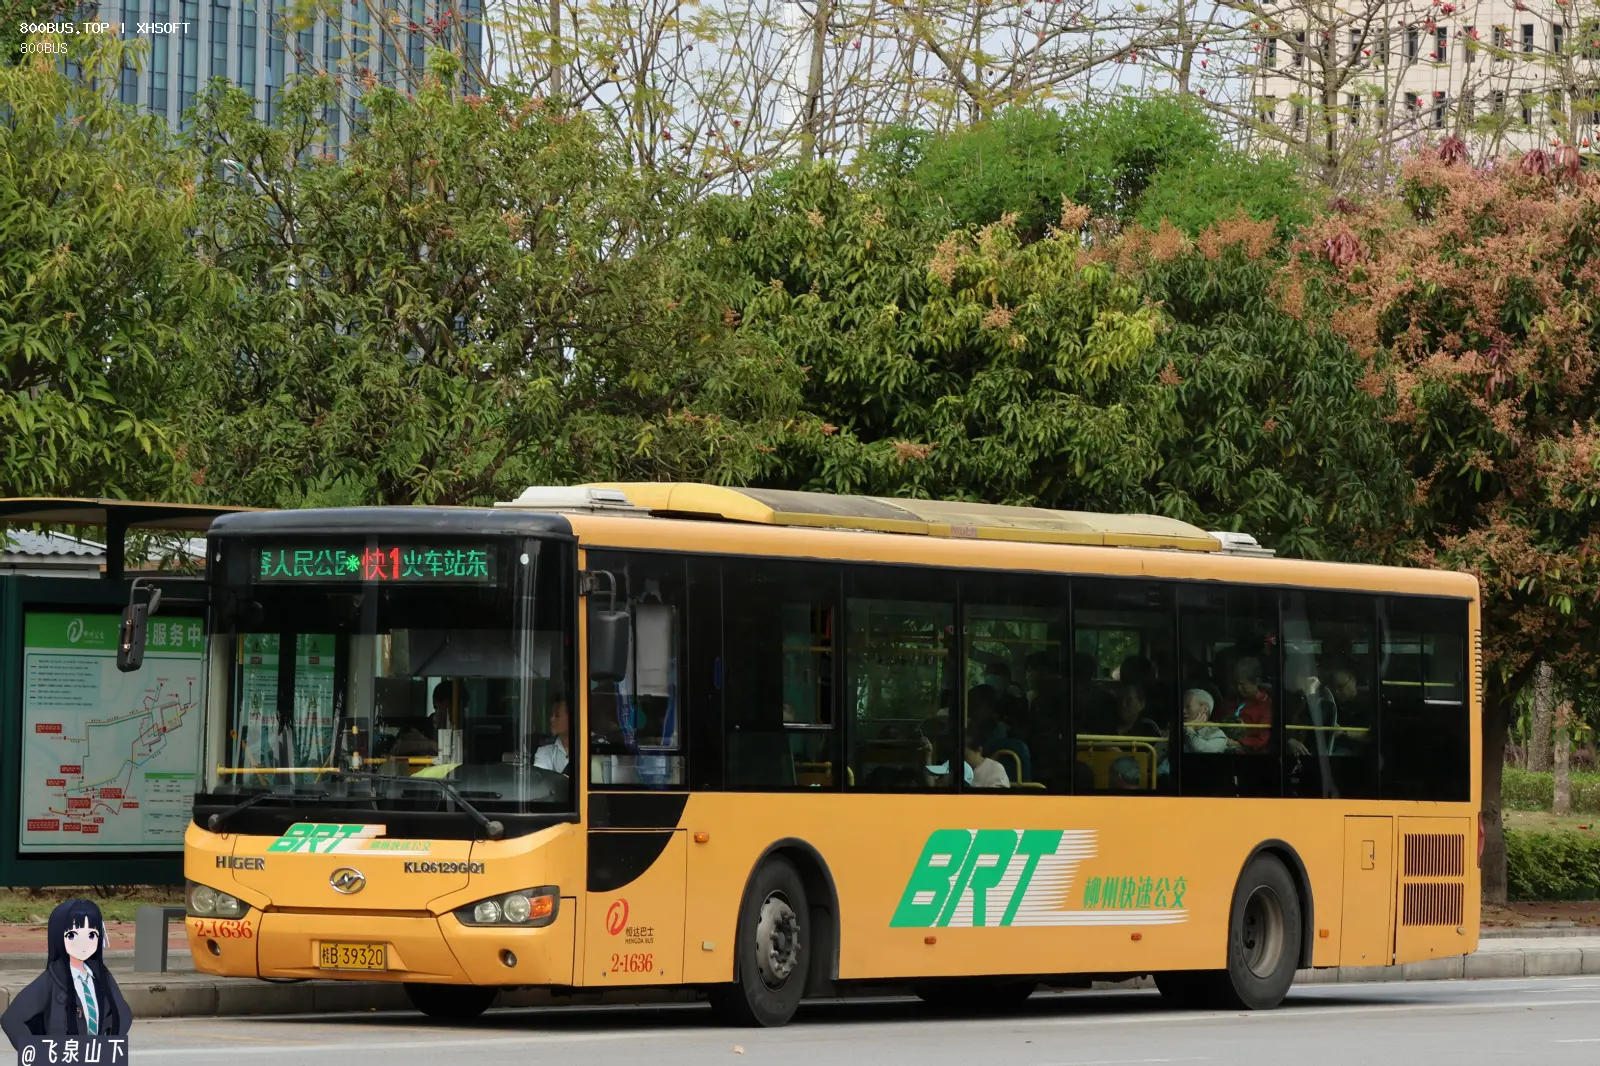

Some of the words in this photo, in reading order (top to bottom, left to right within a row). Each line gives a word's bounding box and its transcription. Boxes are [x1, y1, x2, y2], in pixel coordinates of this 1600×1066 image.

[402, 549, 488, 577] 火车站东
[266, 822, 365, 854] BRT
[215, 855, 265, 870] HIGER
[403, 861, 485, 874] KLQ6129GQ1
[888, 828, 1065, 928] BRT
[1082, 875, 1189, 909] 柳州快速公交
[194, 920, 253, 938] 2-1636
[625, 926, 654, 937] 恒达巴士
[611, 953, 653, 972] 2-1636
